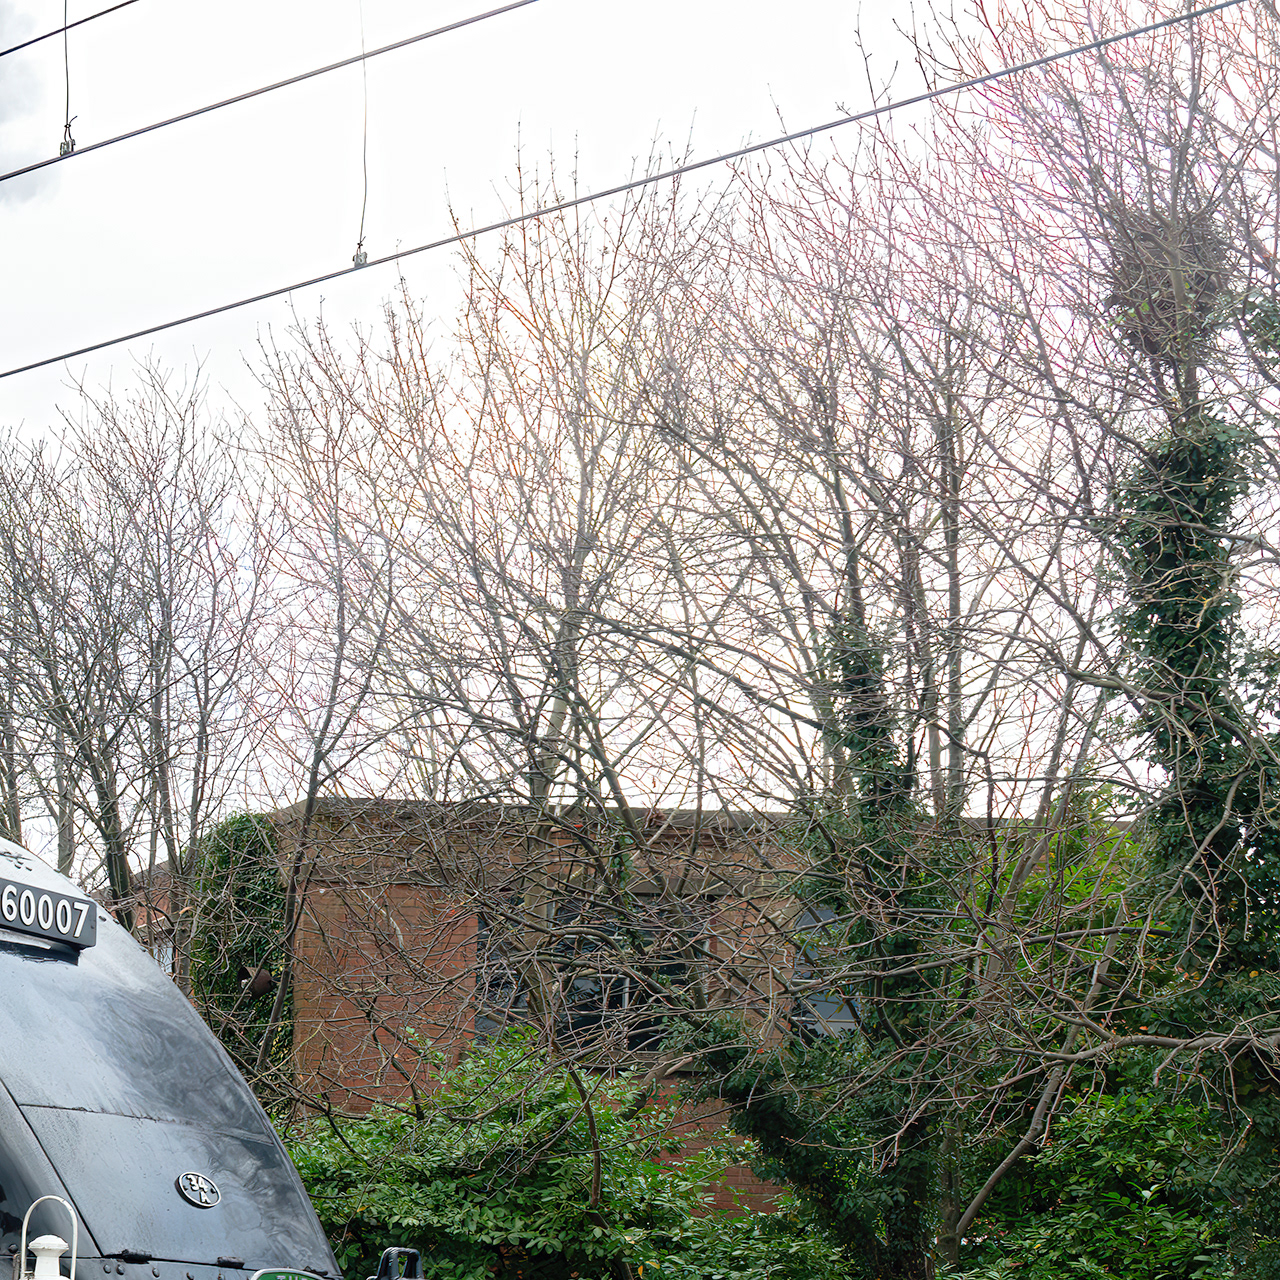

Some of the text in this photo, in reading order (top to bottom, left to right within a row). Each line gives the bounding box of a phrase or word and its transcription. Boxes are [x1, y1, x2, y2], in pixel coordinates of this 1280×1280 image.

[1, 884, 90, 938] 60007
[183, 1174, 209, 1193] 34
[199, 1190, 212, 1203] A
